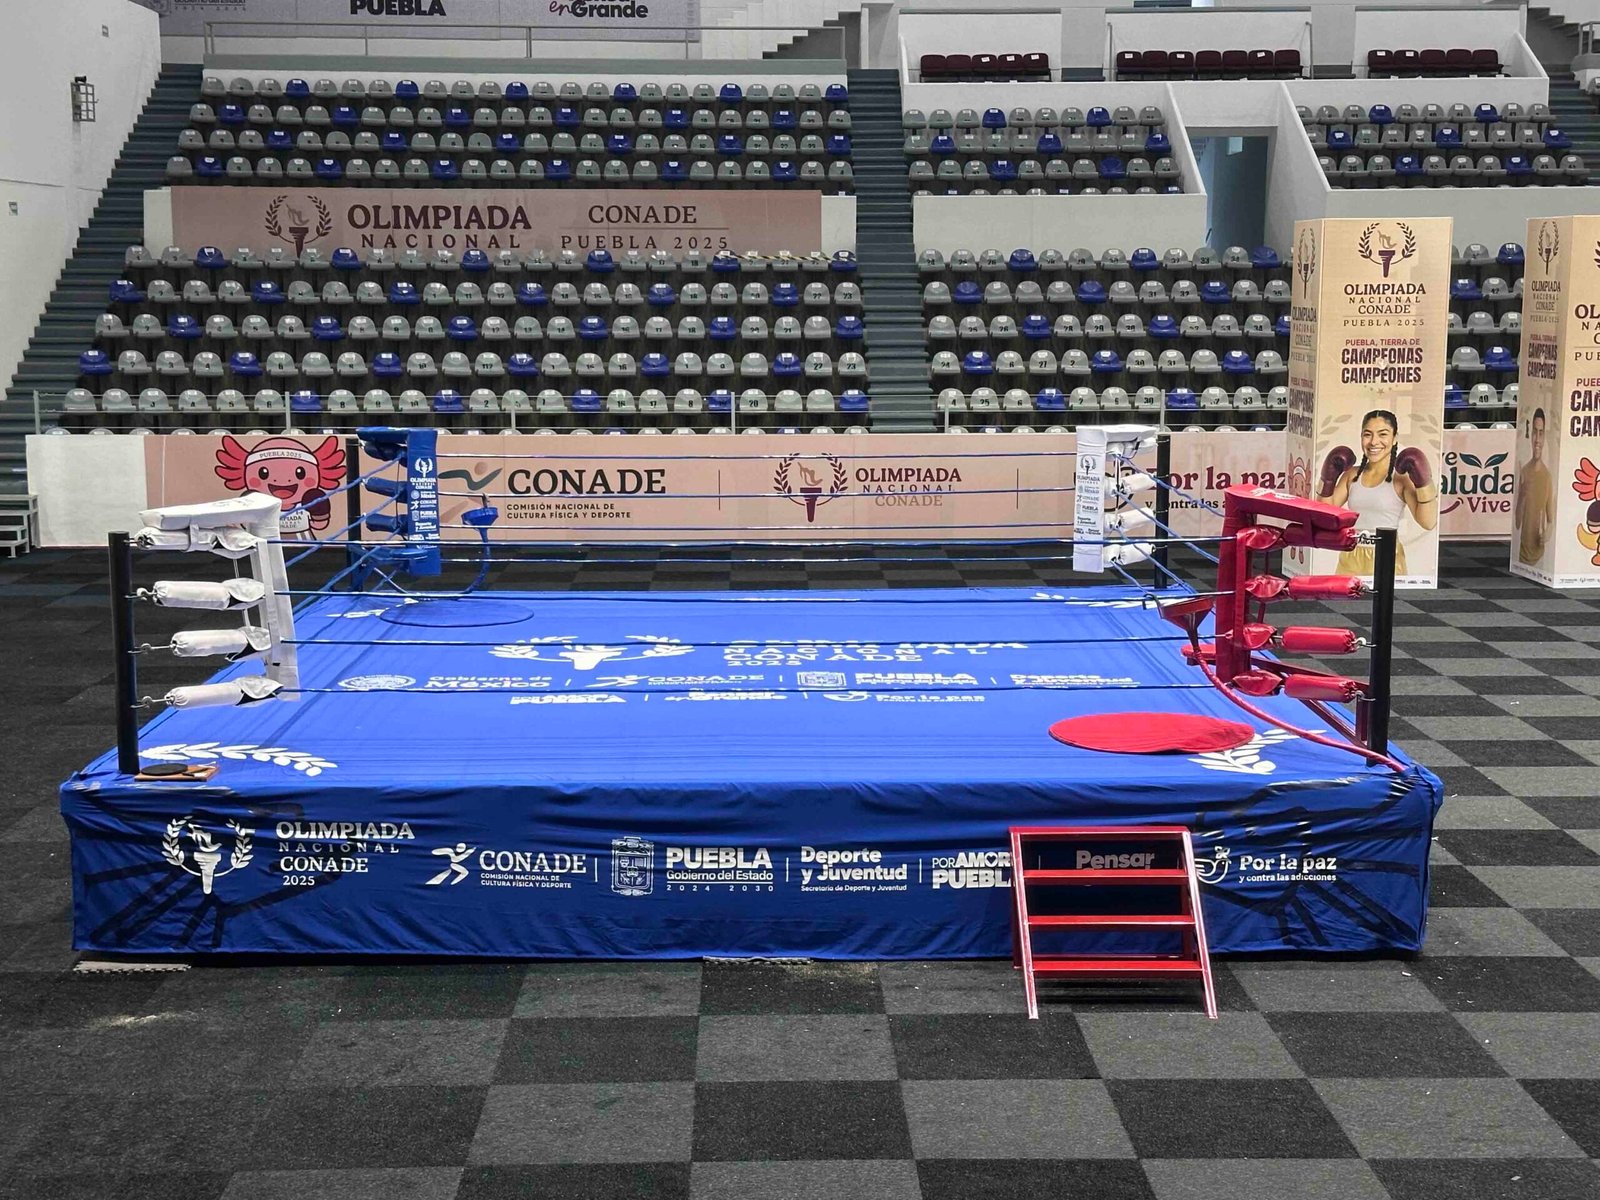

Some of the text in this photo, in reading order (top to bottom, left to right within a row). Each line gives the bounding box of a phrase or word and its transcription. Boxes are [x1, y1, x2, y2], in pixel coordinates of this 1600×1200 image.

[350, 0, 447, 16] PUEBLA
[571, 0, 649, 17] Grande
[347, 204, 697, 230] OLIMPIADA CONADE
[361, 233, 728, 249] NACIONAL PUEBLA 2025
[1344, 283, 1426, 296] OLIMPIADA
[1531, 280, 1561, 292] OLIMPIADA
[1349, 296, 1421, 304] NACIONAL
[1358, 304, 1411, 314] CONADE
[1343, 318, 1425, 327] PUEBLA 2025
[1345, 338, 1421, 347] PUEBLA, TIERRA DE
[1341, 347, 1424, 364] CAMPEONAS
[1341, 366, 1422, 384] CAMPEONES
[259, 450, 286, 458] PUEBLA
[507, 468, 666, 494] CONADE
[855, 467, 962, 483] OLIMPIADA
[1205, 466, 1231, 490] la
[863, 484, 955, 493] NACIONAL
[506, 502, 552, 511] COMISIÓN
[875, 495, 943, 507] CONADE
[1467, 496, 1511, 513] Vive
[550, 511, 579, 519] FÍSICA
[591, 511, 631, 519] DEPORTE
[723, 653, 923, 662] CONADE
[648, 674, 765, 682] CONADE
[275, 821, 415, 840] OLIMPIADA
[279, 841, 400, 854] NACIONAL
[479, 850, 587, 874] CONADE
[666, 847, 773, 869] PUEBLA
[800, 846, 882, 866] Deporte
[1076, 850, 1155, 870] Pensar
[280, 856, 369, 873] CONADE
[1239, 853, 1337, 873] Por la paz
[283, 875, 315, 886] 2025
[480, 872, 514, 880] COMISIÓN
[666, 870, 773, 881] Gobierno del Estado
[800, 863, 908, 885] y Juventud
[932, 869, 1015, 889] PUEBL
[1238, 873, 1337, 883] y contra las adicciones
[512, 880, 535, 888] FÍSICA
[666, 884, 774, 892] 2024 2030
[834, 884, 844, 892] de
[844, 884, 871, 893] Deporte
[871, 885, 877, 893] y
[877, 884, 907, 892] Juventud
